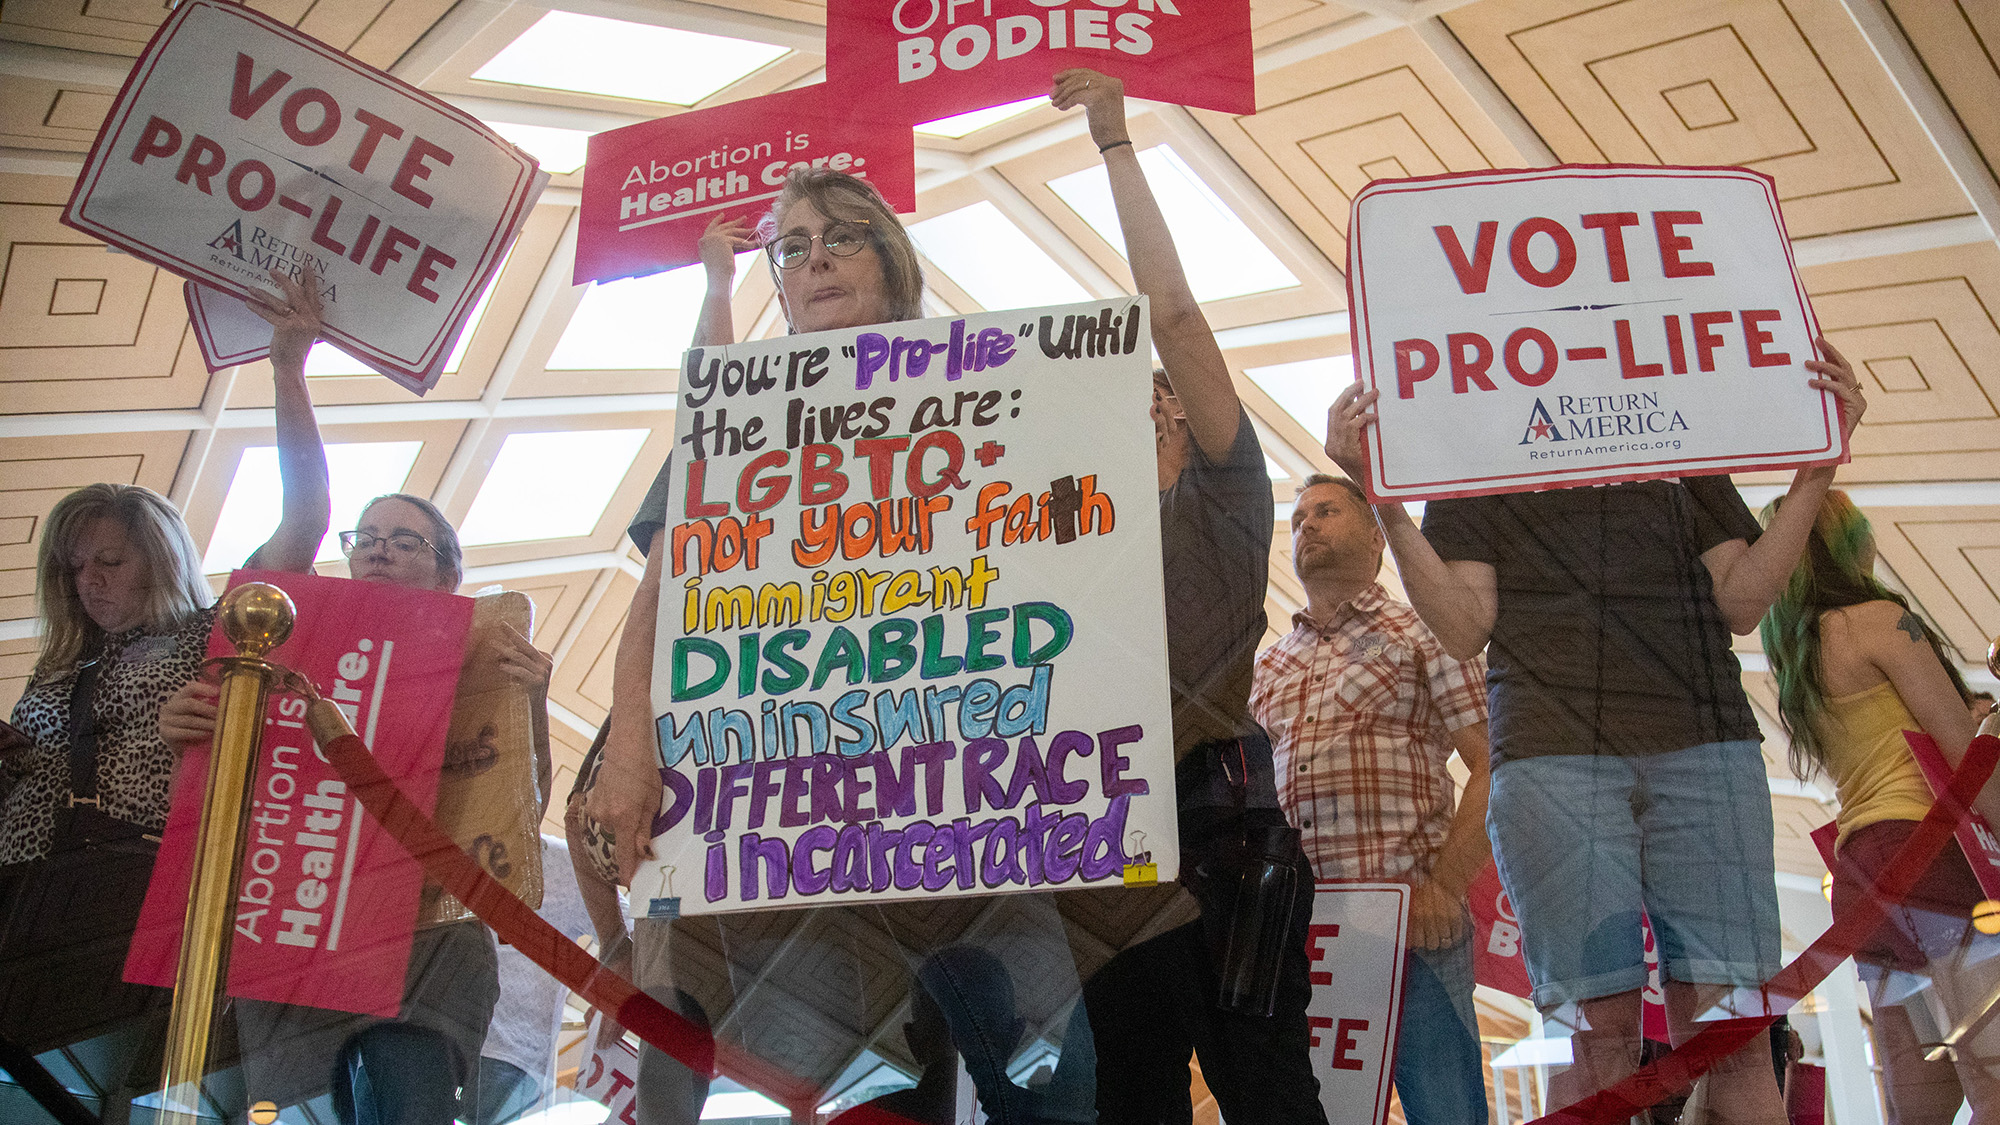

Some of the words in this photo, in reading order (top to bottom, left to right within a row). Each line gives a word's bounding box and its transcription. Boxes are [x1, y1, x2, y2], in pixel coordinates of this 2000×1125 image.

[898, 9, 1153, 84] BODIES
[227, 51, 454, 210] VOTE
[620, 142, 772, 191] Abortion
[785, 130, 810, 153] is
[131, 115, 457, 304] PRO-LIFE
[619, 170, 749, 220] Health
[250, 225, 329, 275] RETURN
[1432, 210, 1715, 295] VOTE
[1393, 309, 1792, 400] PRO-LIFE
[681, 408, 767, 460] the
[786, 398, 896, 449] lives
[909, 389, 1022, 433] are:
[1518, 397, 1690, 446] AMERICA
[1557, 391, 1659, 416] RETURN
[684, 429, 1006, 519] LGBTQ+
[1530, 438, 1682, 460] ReturnAmerica.org
[671, 512, 774, 580] not
[791, 494, 954, 568] your
[965, 474, 1116, 550] faith
[682, 556, 1000, 634] immigrant
[671, 601, 1074, 702] DISABLED
[266, 698, 307, 729] is
[656, 663, 1053, 768] uninsured
[962, 724, 1150, 814] RACE
[235, 745, 299, 944] Abortion
[276, 779, 347, 950] Health
[703, 794, 1151, 903] incarcerated
